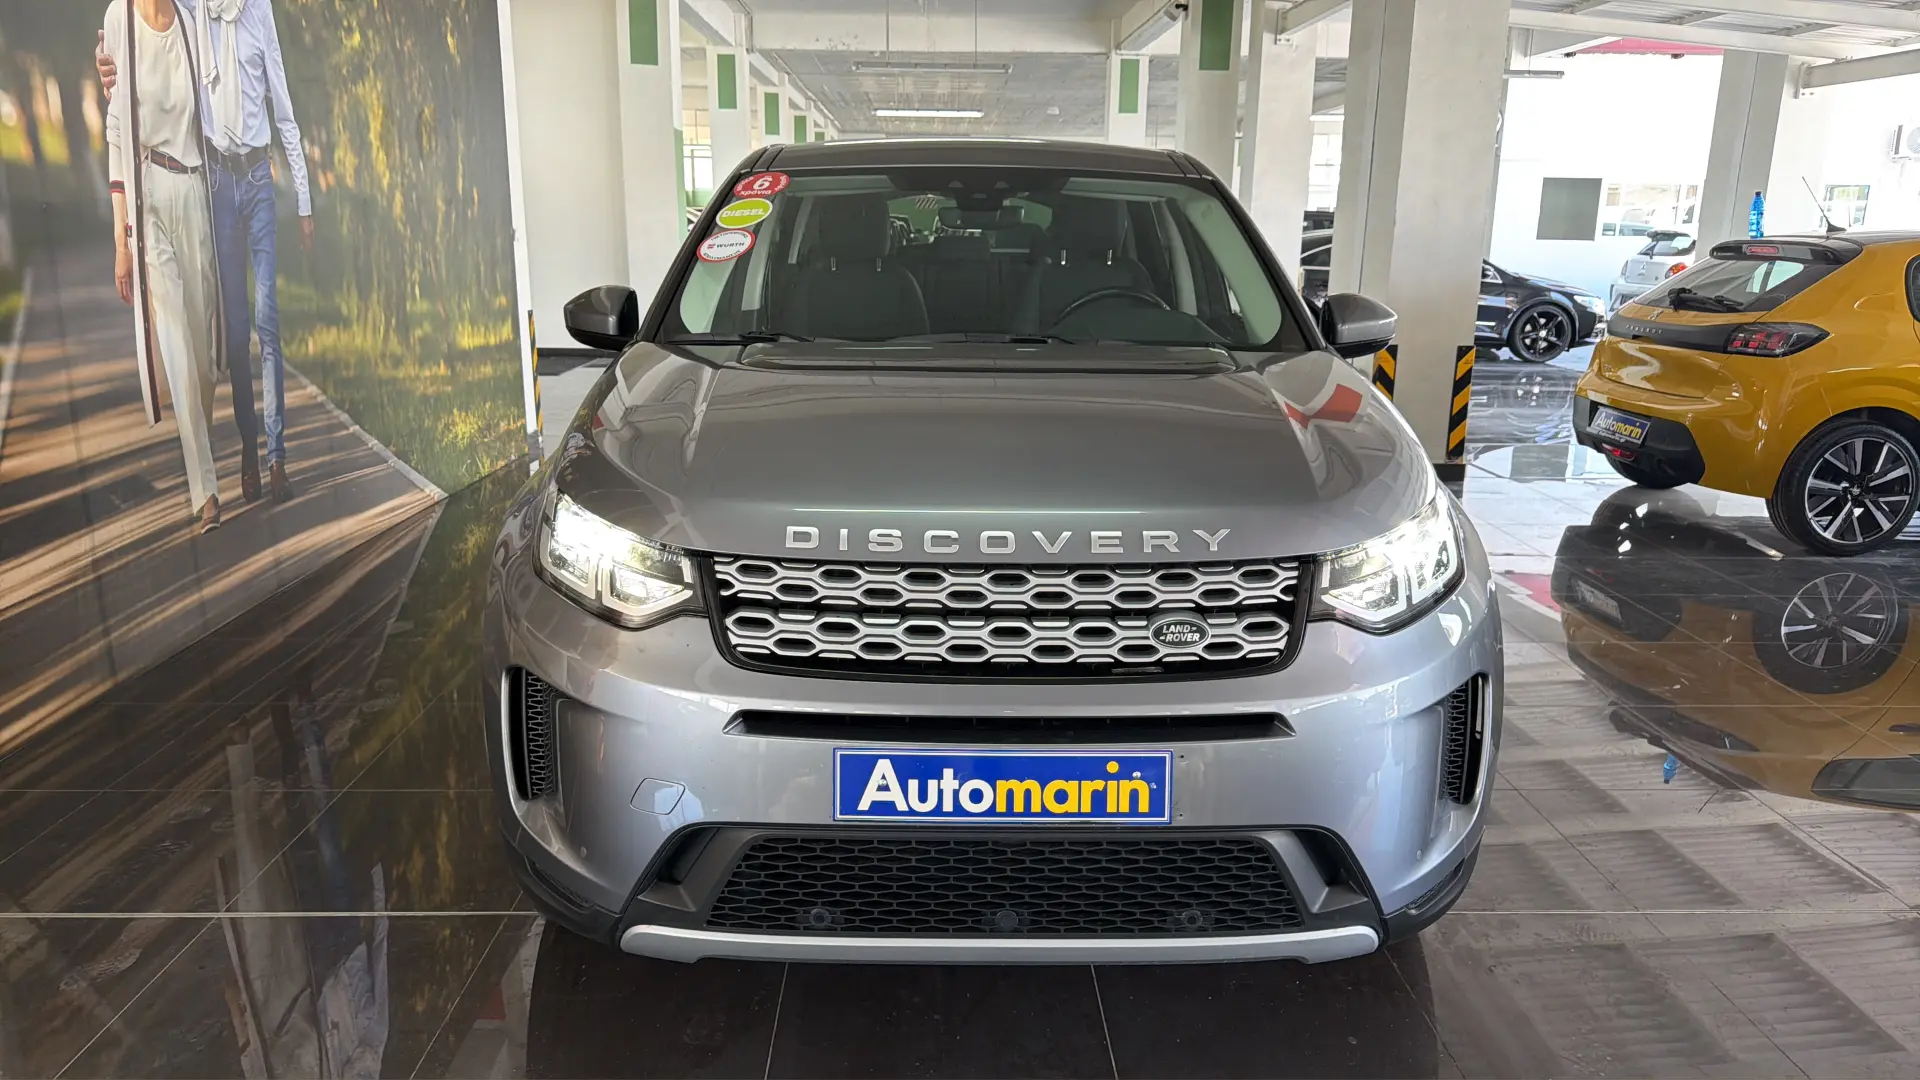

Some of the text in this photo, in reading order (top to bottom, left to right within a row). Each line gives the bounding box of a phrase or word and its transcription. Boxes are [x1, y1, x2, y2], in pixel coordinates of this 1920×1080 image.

[752, 177, 773, 190] 6
[722, 208, 765, 218] DIESEL
[1595, 411, 1642, 439] Automarin
[785, 525, 1231, 554] DISCOVERY
[1162, 625, 1191, 633] LAND
[1165, 633, 1200, 642] ROVER
[857, 758, 1150, 814] Automarin
